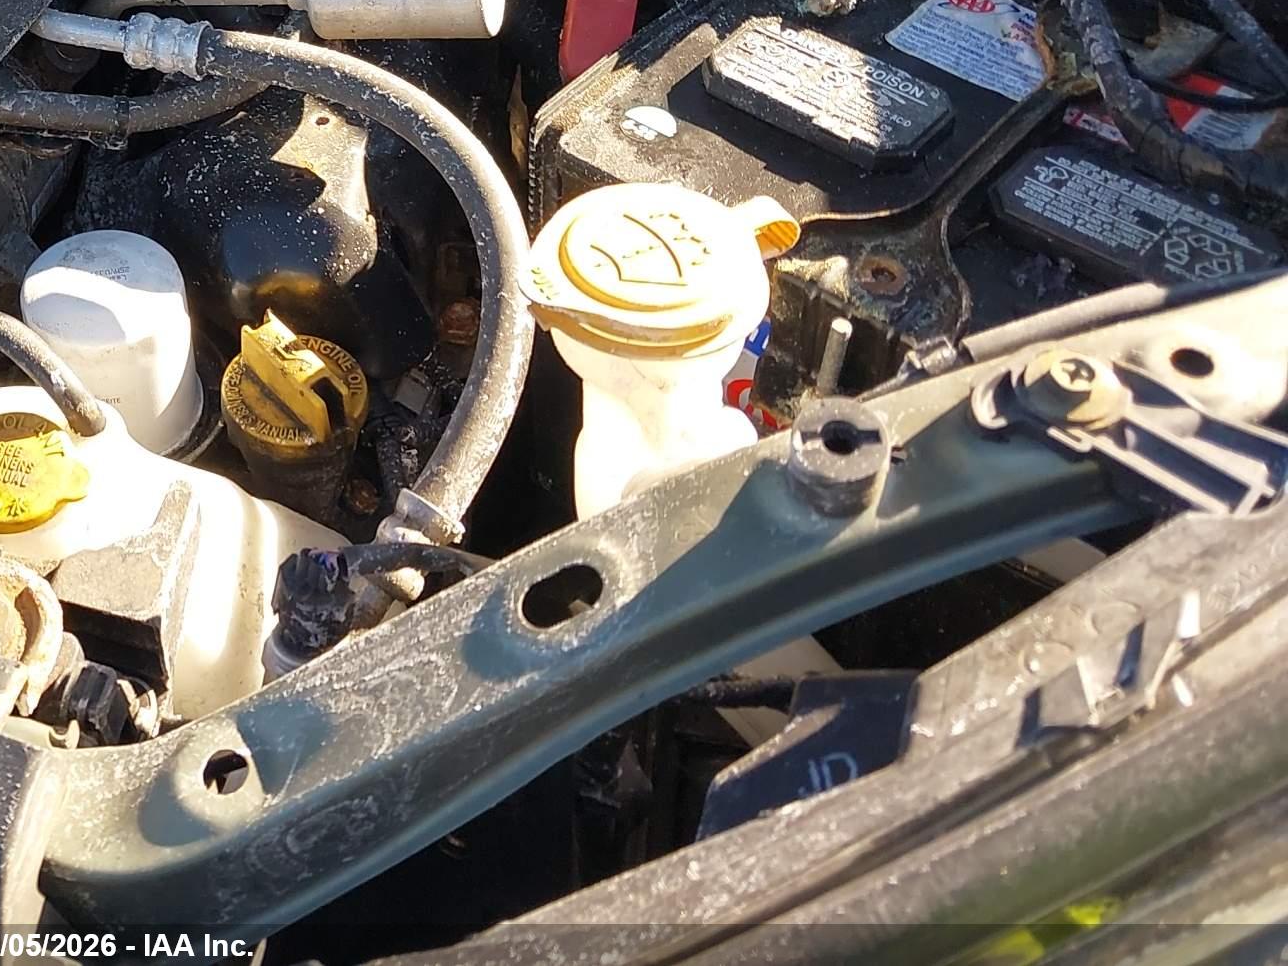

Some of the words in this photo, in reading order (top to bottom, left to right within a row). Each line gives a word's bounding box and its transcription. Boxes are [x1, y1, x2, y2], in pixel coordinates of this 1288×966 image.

[780, 29, 848, 67] DANGER
[863, 64, 925, 100] POISON
[300, 337, 353, 372] ENGINE
[347, 373, 364, 397] OIL
